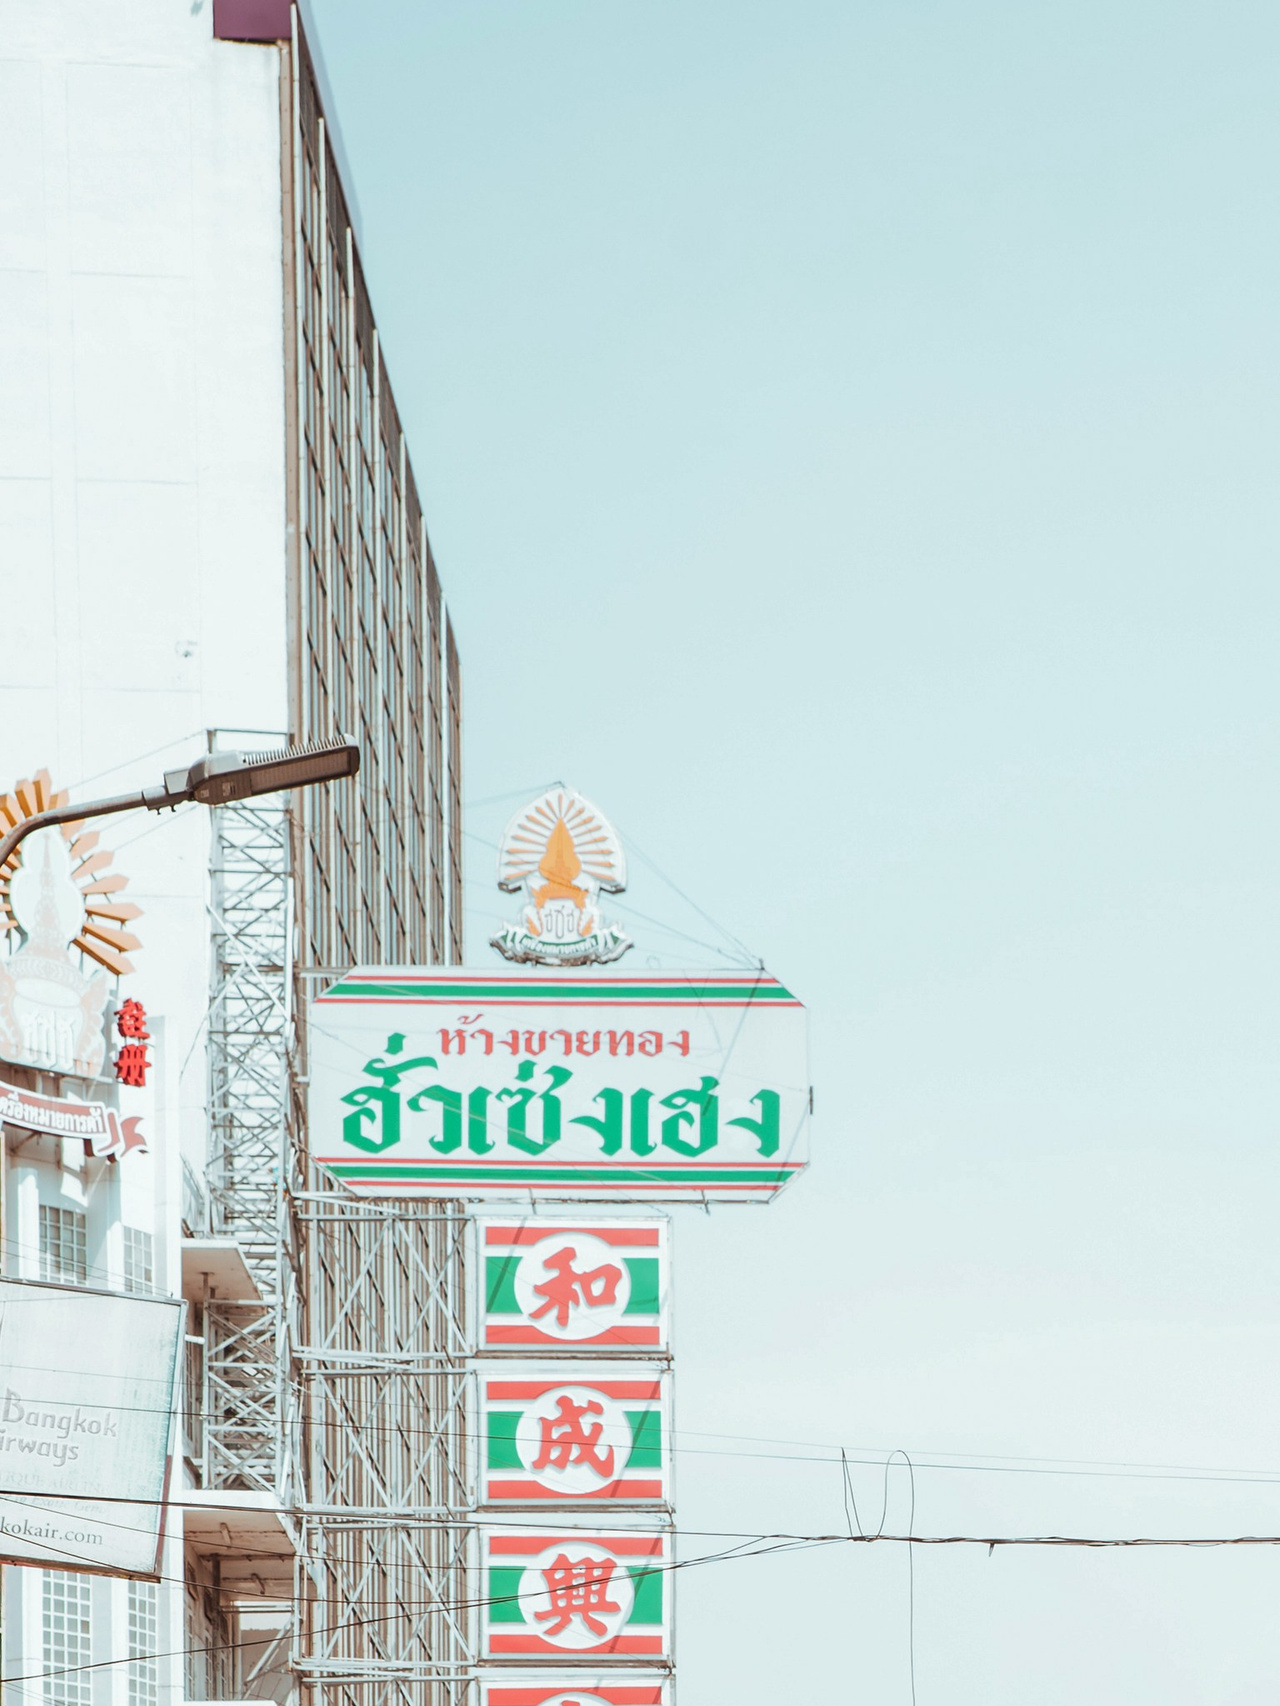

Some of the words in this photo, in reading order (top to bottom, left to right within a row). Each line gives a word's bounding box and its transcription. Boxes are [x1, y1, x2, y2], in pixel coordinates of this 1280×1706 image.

[438, 1014, 691, 1058] ห้างขายทอง
[341, 1033, 781, 1158] ฮั่วเซ่งเฮง
[2, 1387, 118, 1440] Bangkok
[0, 1429, 79, 1467] irways
